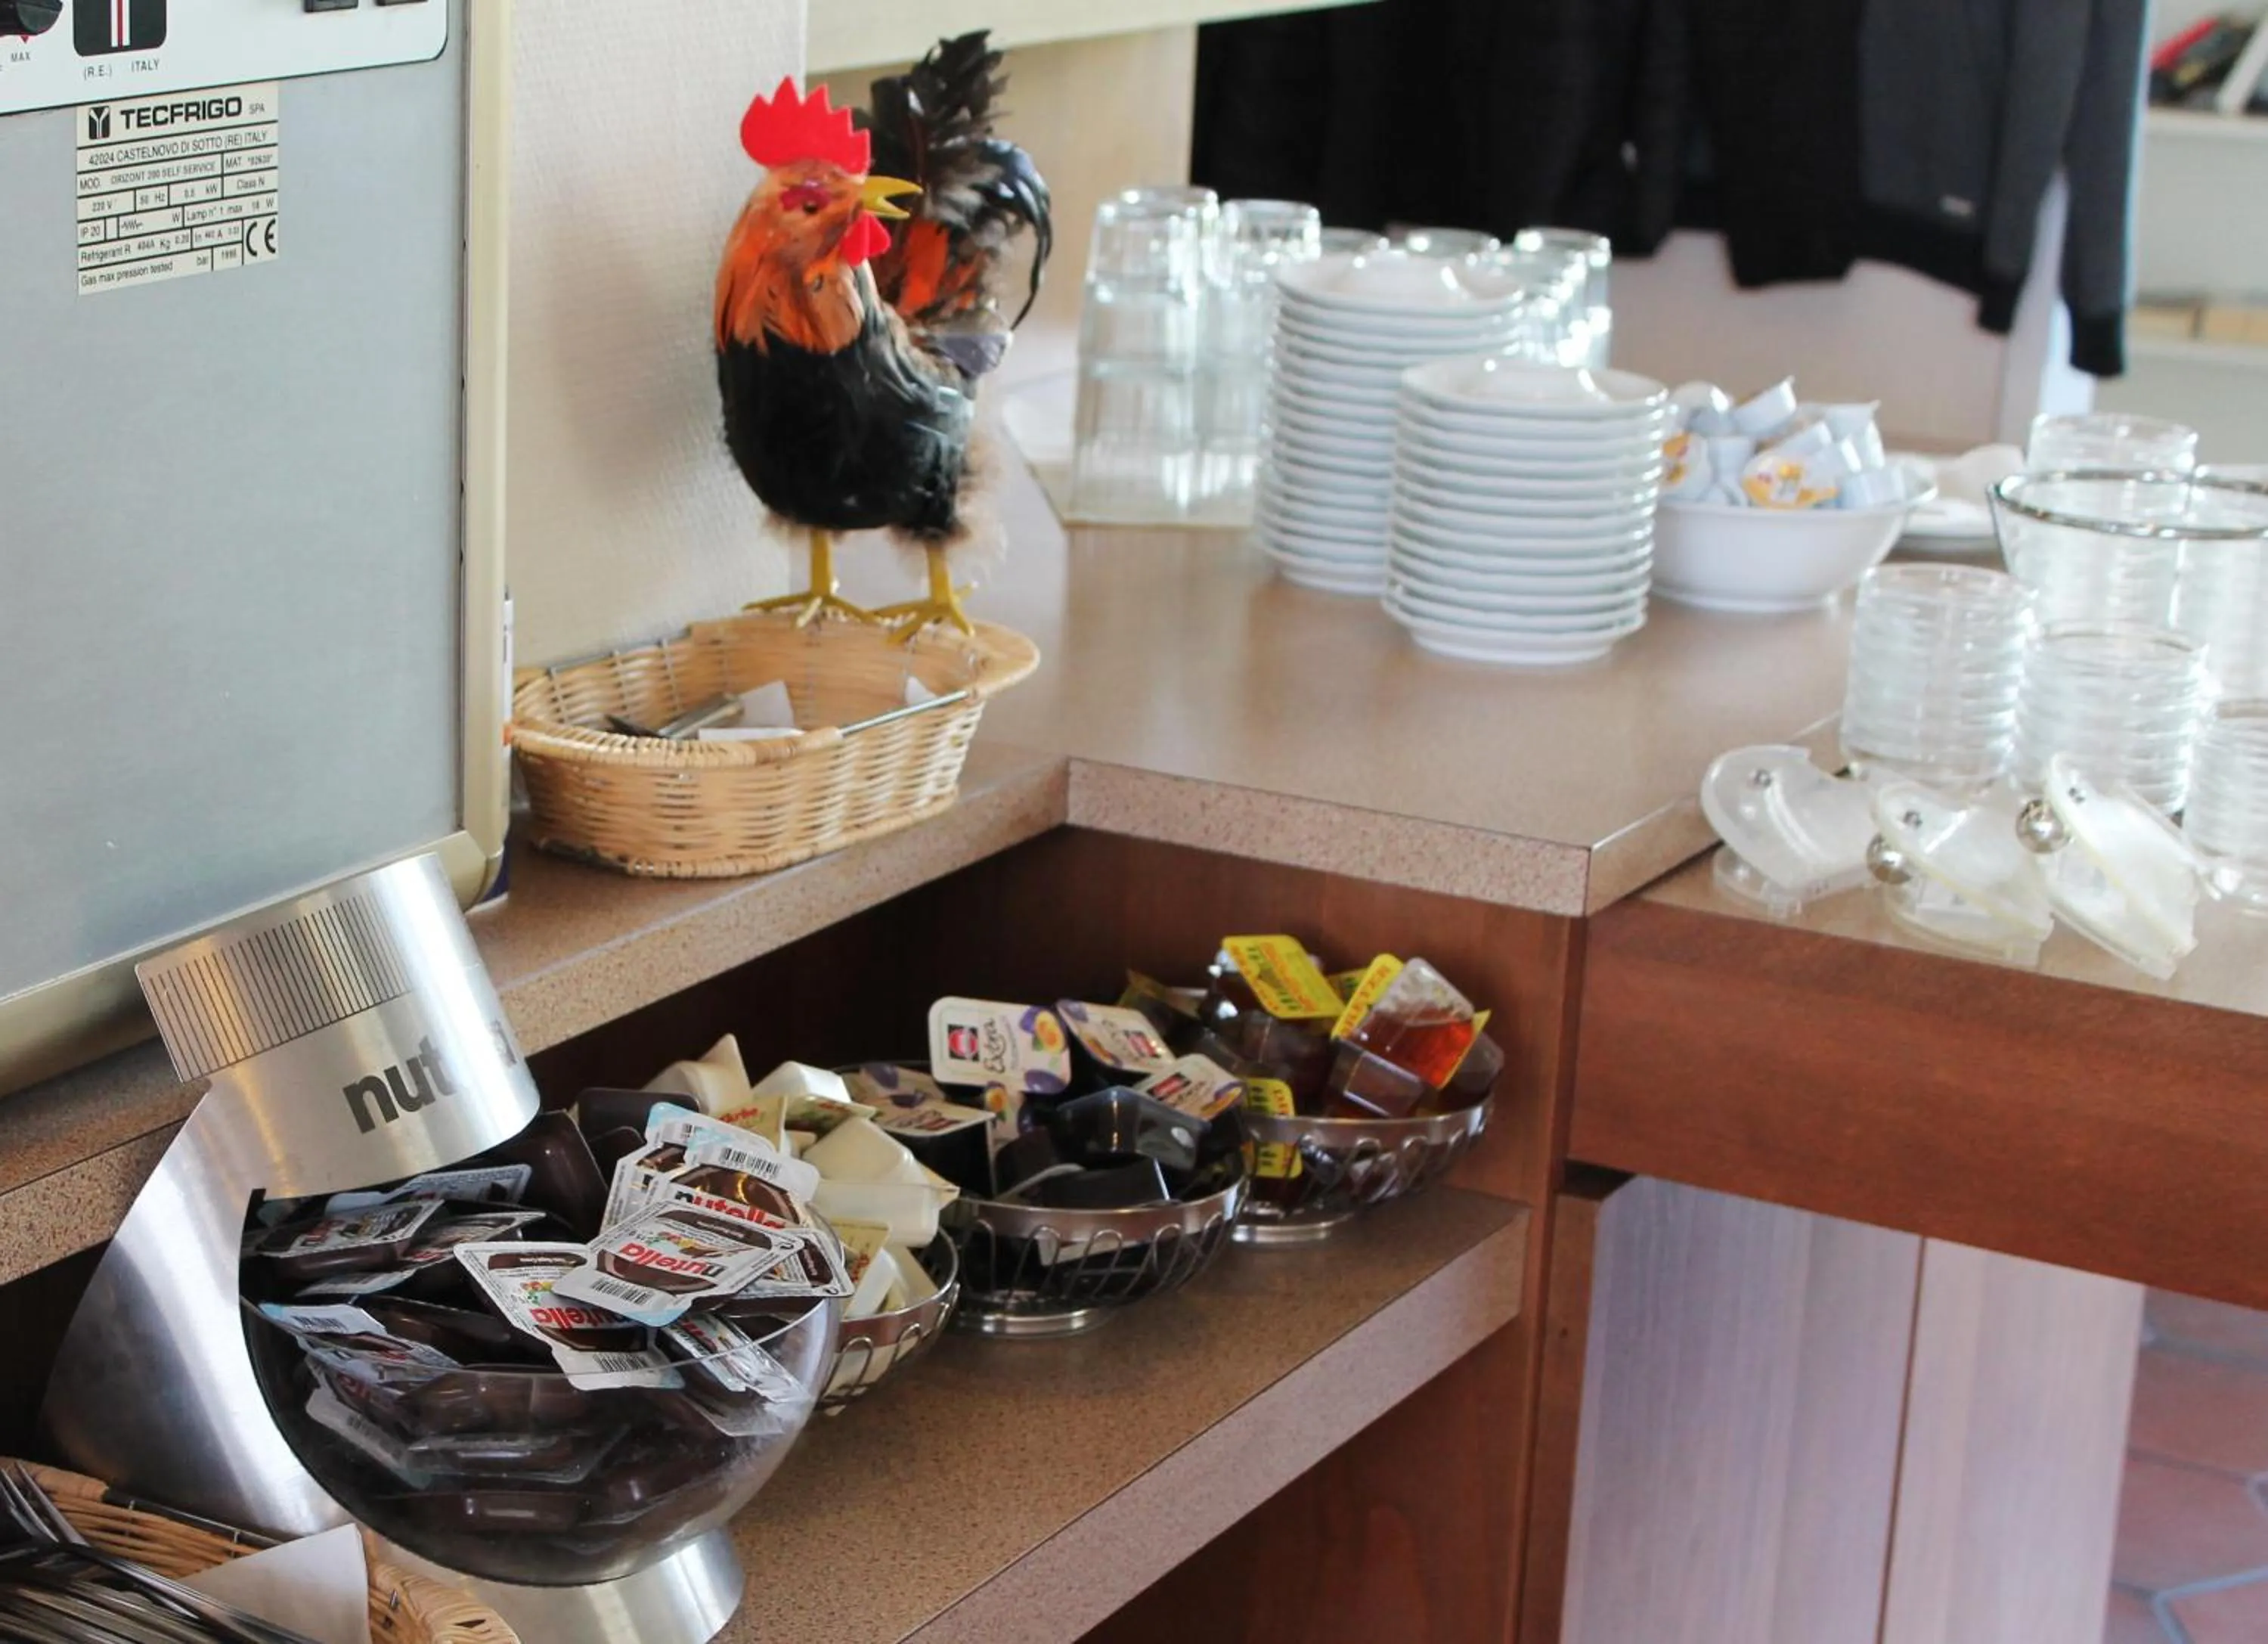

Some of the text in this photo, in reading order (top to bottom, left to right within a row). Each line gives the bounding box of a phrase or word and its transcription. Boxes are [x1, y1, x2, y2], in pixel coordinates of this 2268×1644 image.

[11, 51, 31, 62] MAX
[132, 59, 160, 73] ITALY
[119, 96, 265, 129] TECFRIGO SPA
[88, 130, 268, 166] 42024 CASTELNOVO DI SOTTO (RE) ITALY
[205, 183, 218, 194] kW
[237, 176, 265, 190] Class N
[154, 191, 166, 203] Hz
[171, 212, 181, 223] W
[186, 209, 207, 222] Lamp
[265, 197, 274, 207] W
[80, 247, 123, 262] Refrigerant
[159, 237, 171, 251] Kg
[80, 260, 173, 287] Gas max pression tested
[618, 1242, 724, 1278] nutella
